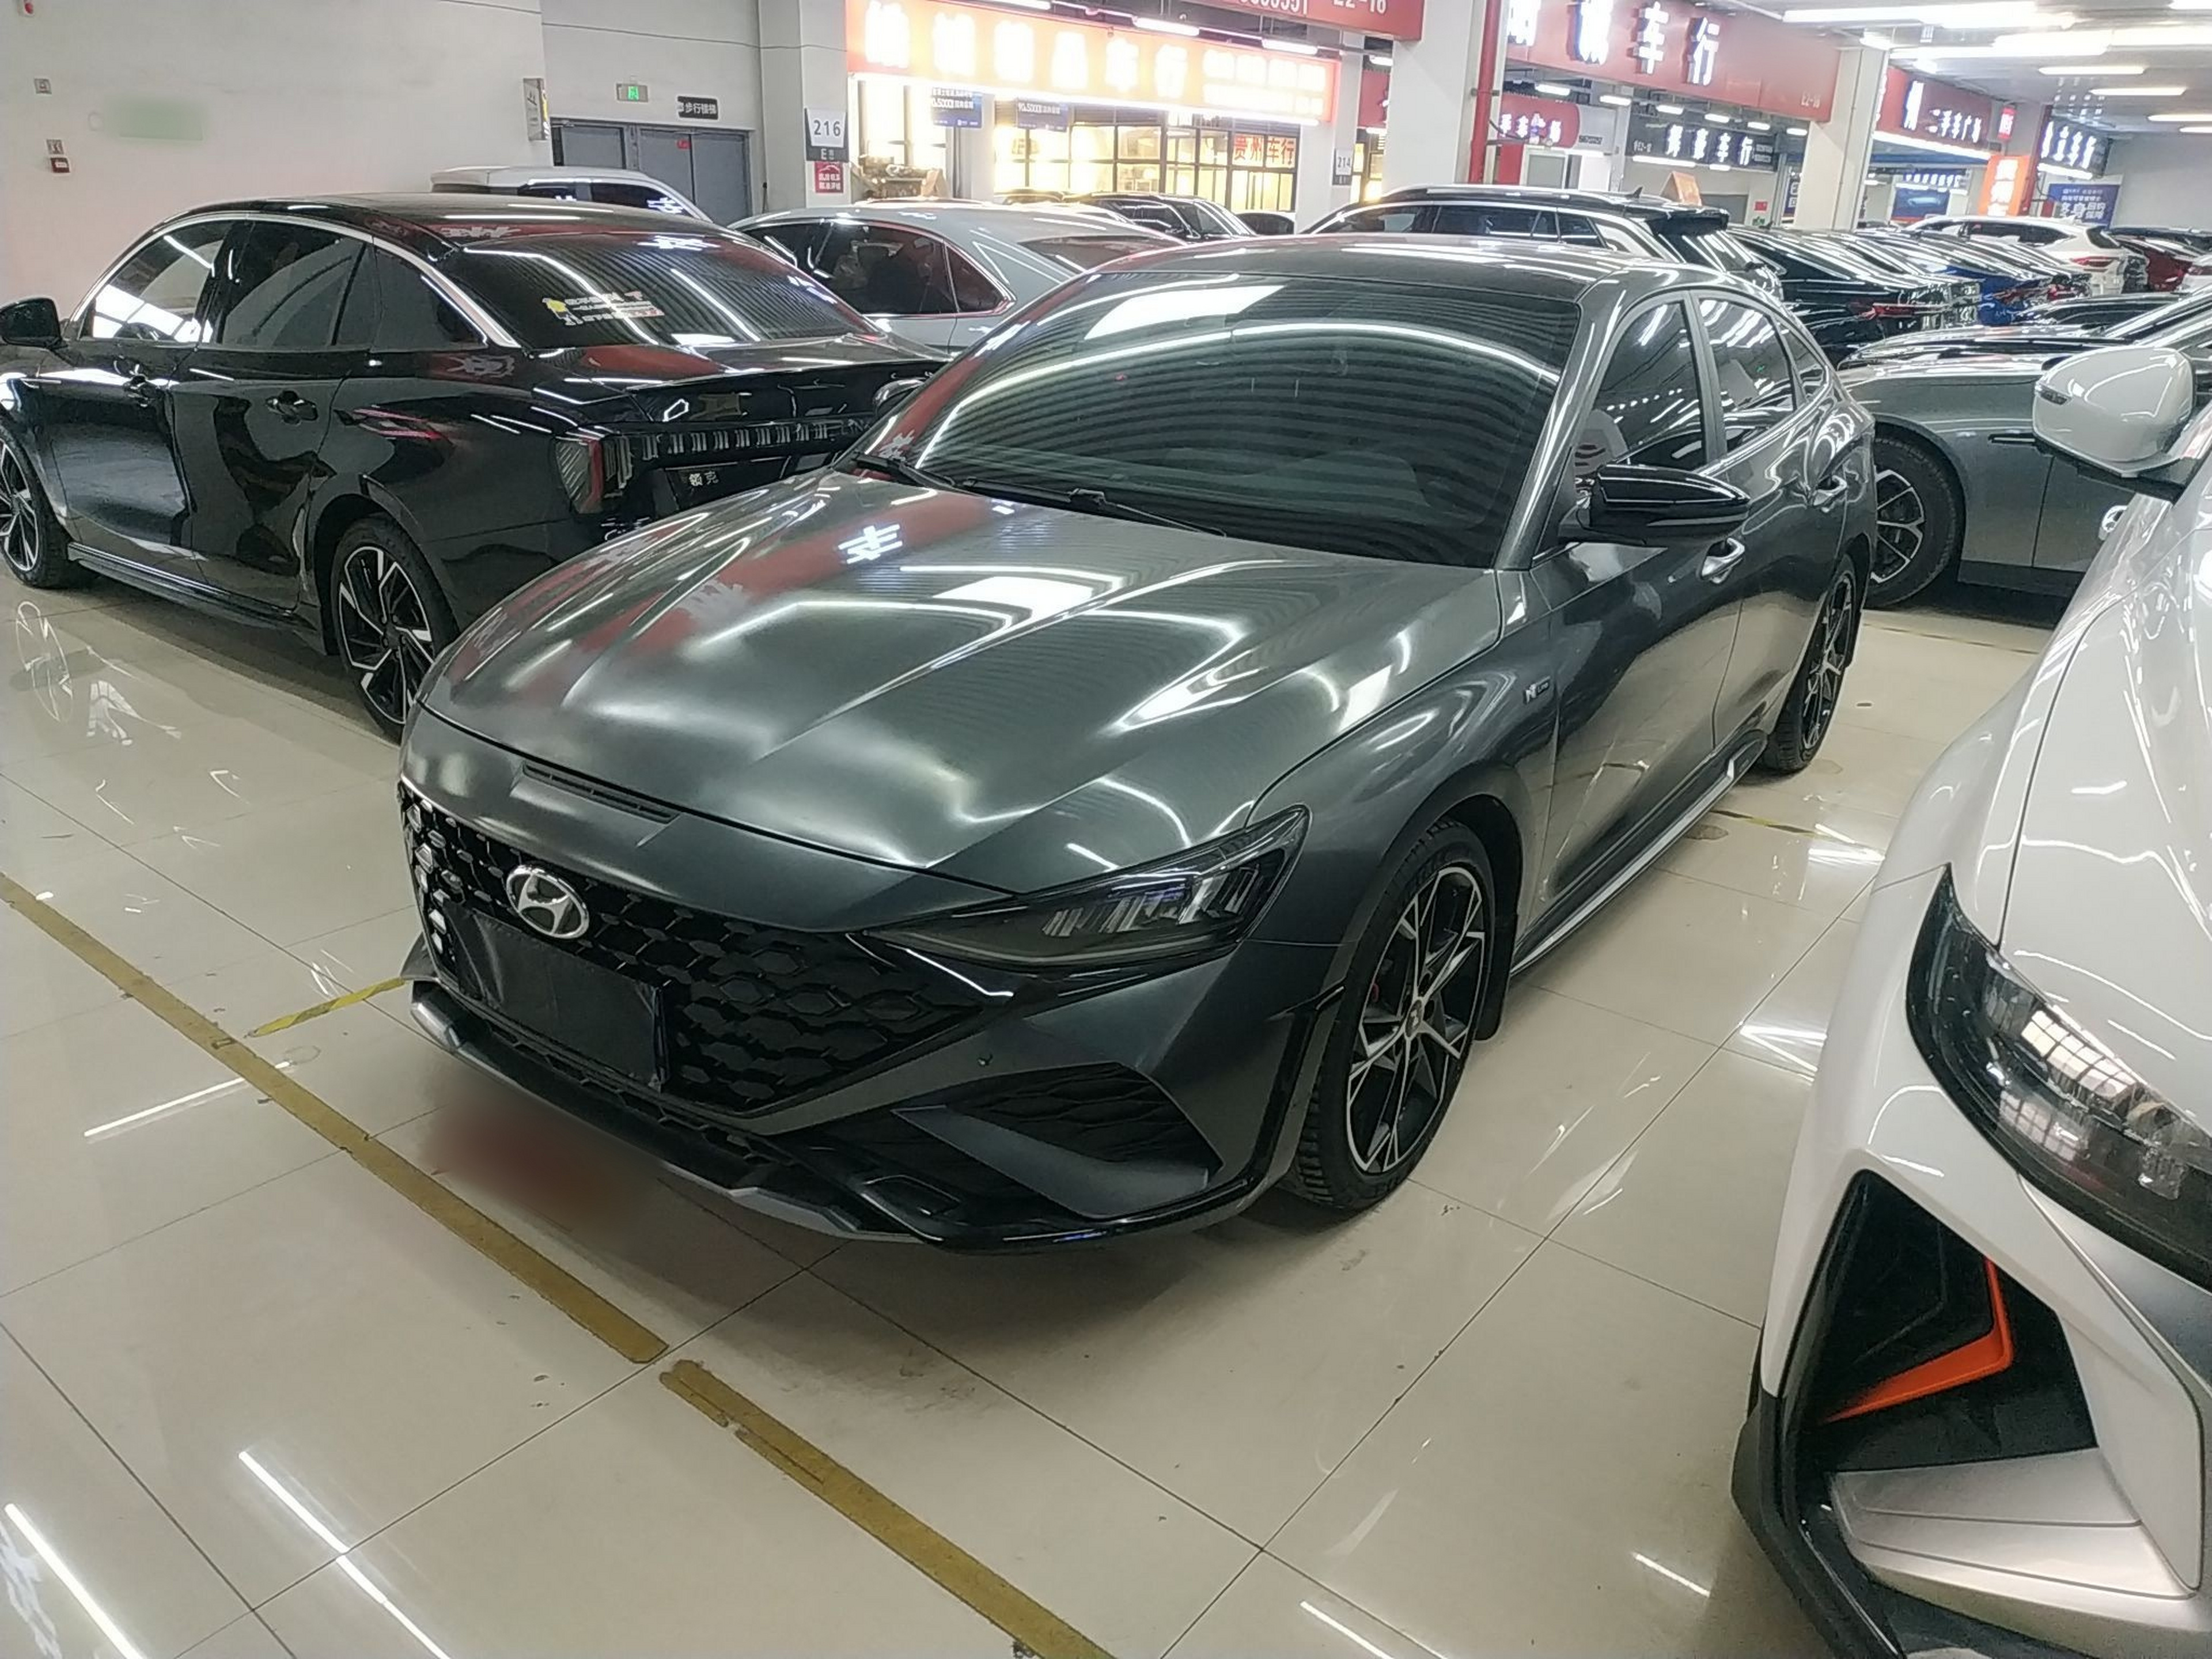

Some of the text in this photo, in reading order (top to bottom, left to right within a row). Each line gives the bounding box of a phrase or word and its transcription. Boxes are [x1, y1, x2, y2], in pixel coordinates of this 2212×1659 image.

[813, 119, 841, 137] 216
[1234, 134, 1295, 165] 贵州车行
